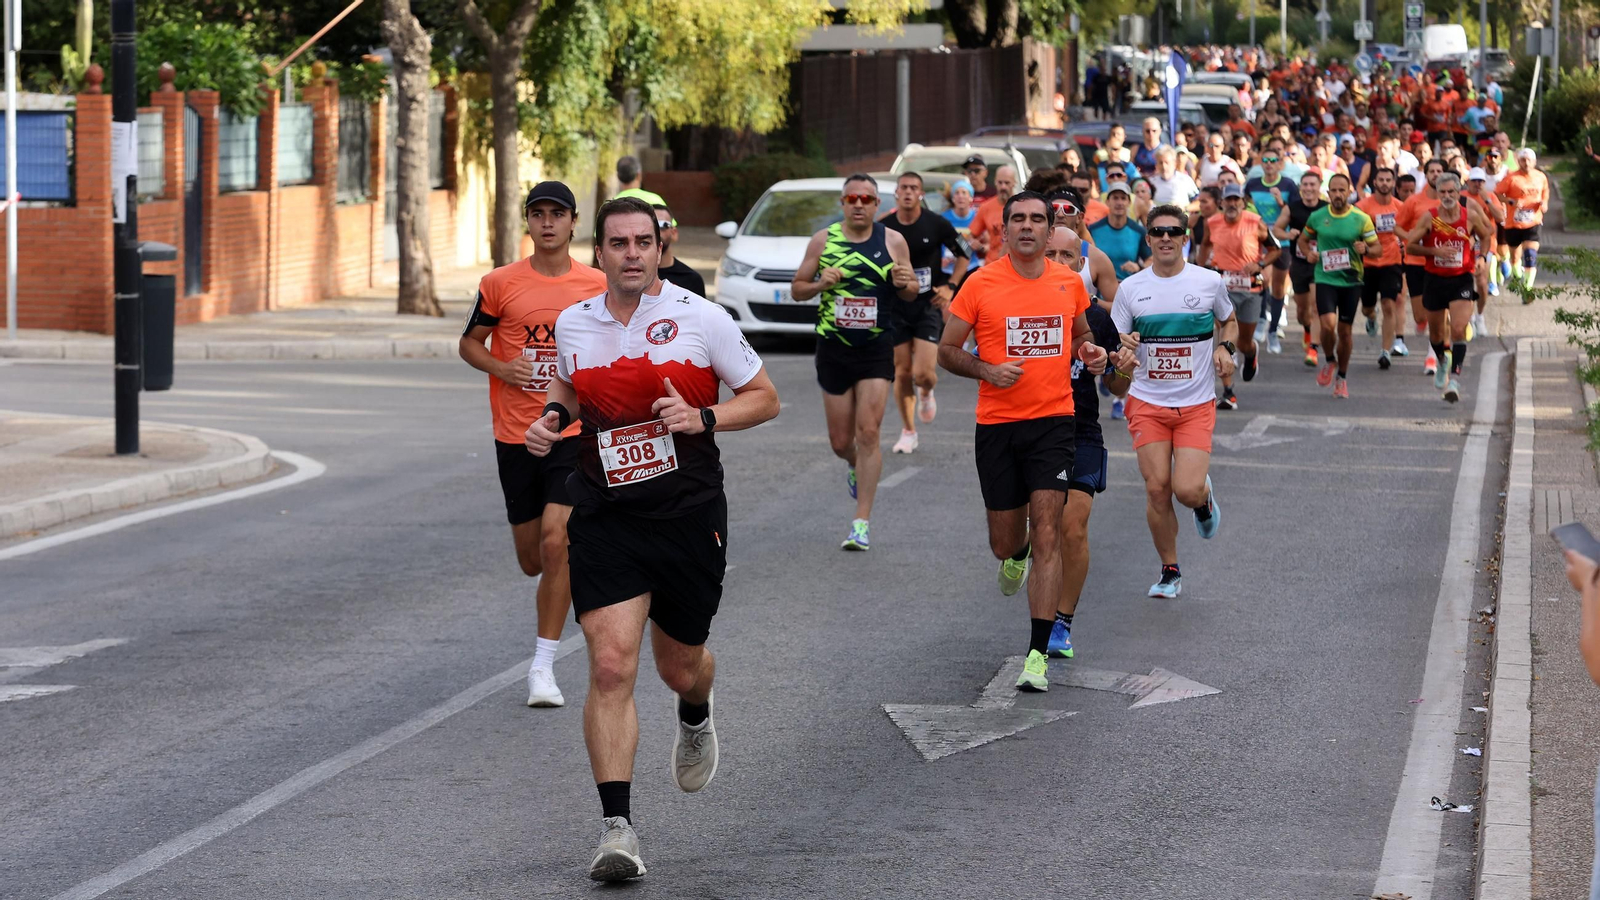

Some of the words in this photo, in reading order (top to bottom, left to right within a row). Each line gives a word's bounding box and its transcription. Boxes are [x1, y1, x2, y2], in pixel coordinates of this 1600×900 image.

[844, 307, 866, 318] 496
[1021, 330, 1049, 344] 291
[1157, 358, 1182, 370] 234
[616, 442, 656, 466] 308
